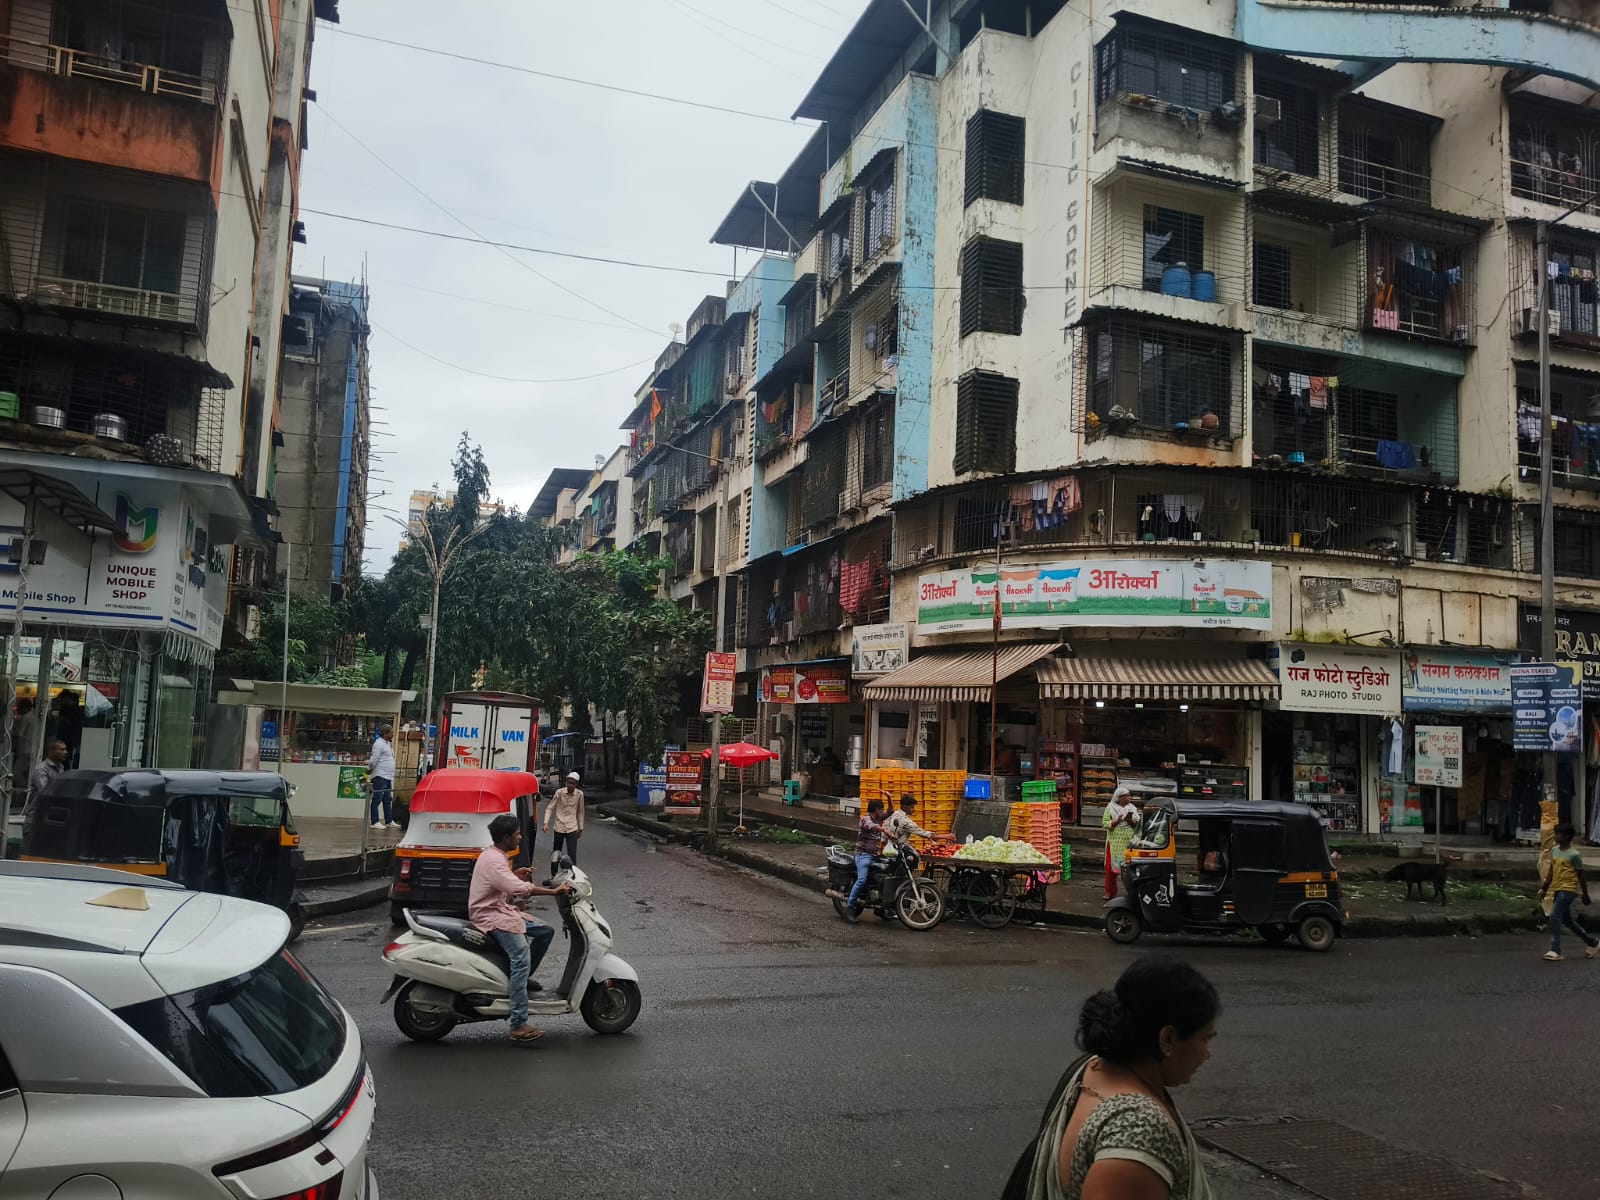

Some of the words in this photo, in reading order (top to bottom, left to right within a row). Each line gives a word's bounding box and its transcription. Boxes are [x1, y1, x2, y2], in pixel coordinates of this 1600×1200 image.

[1067, 61, 1082, 185] CIVIC
[107, 564, 157, 577] UNIQUE
[106, 576, 156, 589] MOBILE
[46, 593, 76, 604] Shop
[112, 589, 147, 600] SHOP
[1287, 666, 1310, 682] राज
[1313, 662, 1344, 684] फोटो
[1345, 665, 1390, 691] स्टुडिओ
[1453, 662, 1501, 681] कलेक्शन
[1301, 689, 1317, 698] RAJ
[1319, 690, 1348, 700] PHOTO
[1352, 692, 1382, 701] STUDIO
[451, 726, 479, 738] MILK
[501, 730, 524, 742] VAN
